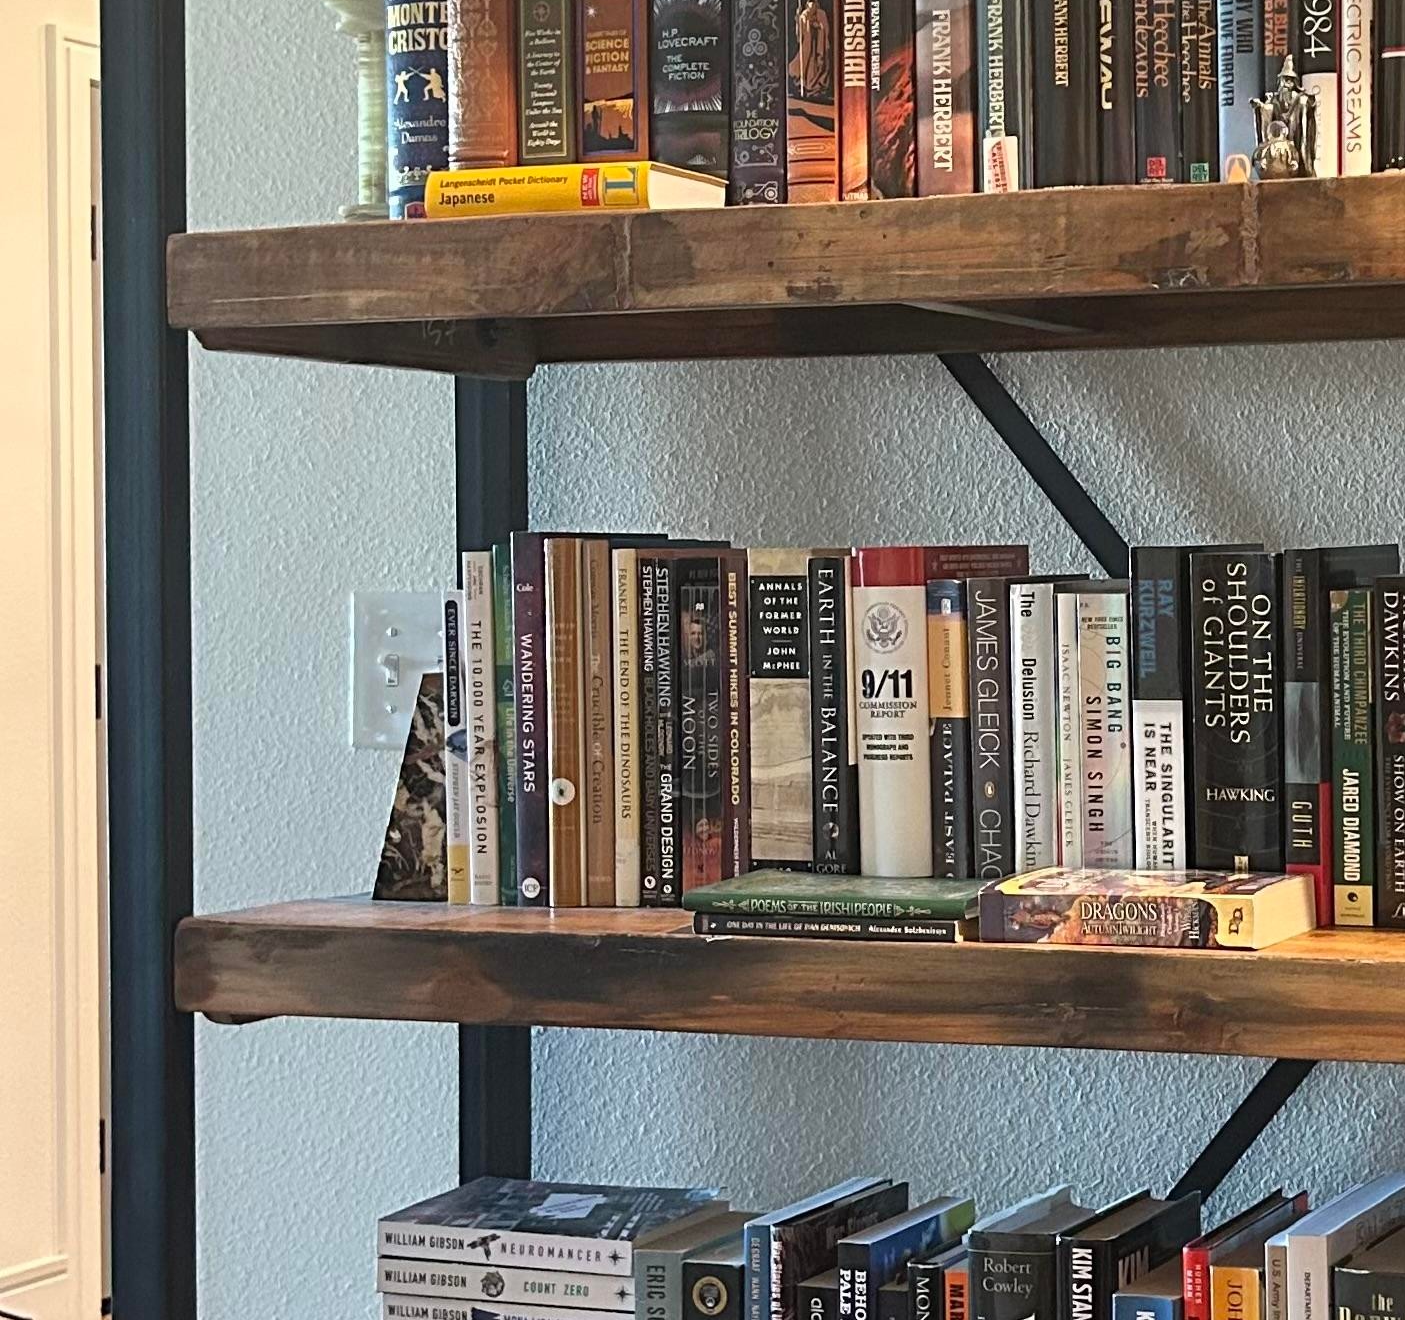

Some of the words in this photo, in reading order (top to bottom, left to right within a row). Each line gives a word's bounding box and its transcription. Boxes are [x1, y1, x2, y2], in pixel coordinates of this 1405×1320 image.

[658, 37, 718, 49] LOVECRAFT
[932, 9, 951, 78] FRANK
[662, 62, 709, 72] COMPLETE
[668, 71, 704, 80] FICTION
[933, 82, 953, 171] HERBERT
[439, 177, 496, 188] Langenscheidt
[499, 176, 524, 185] Pocket
[527, 175, 568, 185] Dictionary
[439, 192, 494, 206] Japanese
[758, 582, 803, 591] ANNALS
[1204, 580, 1222, 604] of
[759, 611, 803, 620] FORMER
[818, 569, 835, 645] EARTH
[762, 626, 799, 634] WORLD
[975, 591, 998, 674] JAMES
[766, 647, 795, 656] JOHN
[1106, 637, 1120, 674] BIG
[1227, 563, 1250, 744] SHOULDERS
[1384, 592, 1399, 701] DAWKINS
[822, 656, 831, 668] IN
[1204, 617, 1225, 727] GIANTS
[521, 634, 535, 733] WANDERING
[823, 674, 833, 700] THE
[861, 669, 913, 699] 9/11
[859, 701, 917, 710] COMMISSION
[870, 710, 905, 718] REPORT
[1108, 683, 1122, 733] BANG
[978, 679, 1000, 769] GLEICK
[1086, 696, 1102, 764] SIMON
[523, 737, 535, 792] STARS
[820, 708, 838, 812] BALANCE
[1088, 773, 1104, 832] SINGH
[1206, 787, 1275, 802] HAWKING
[385, 1233, 426, 1248] WILLIAM
[429, 1235, 465, 1250] GIBSON
[501, 1245, 602, 1262] NEUROMANCER
[1072, 1247, 1092, 1277] KIM
[647, 1265, 665, 1303] ERIC
[1371, 1294, 1393, 1312] the
